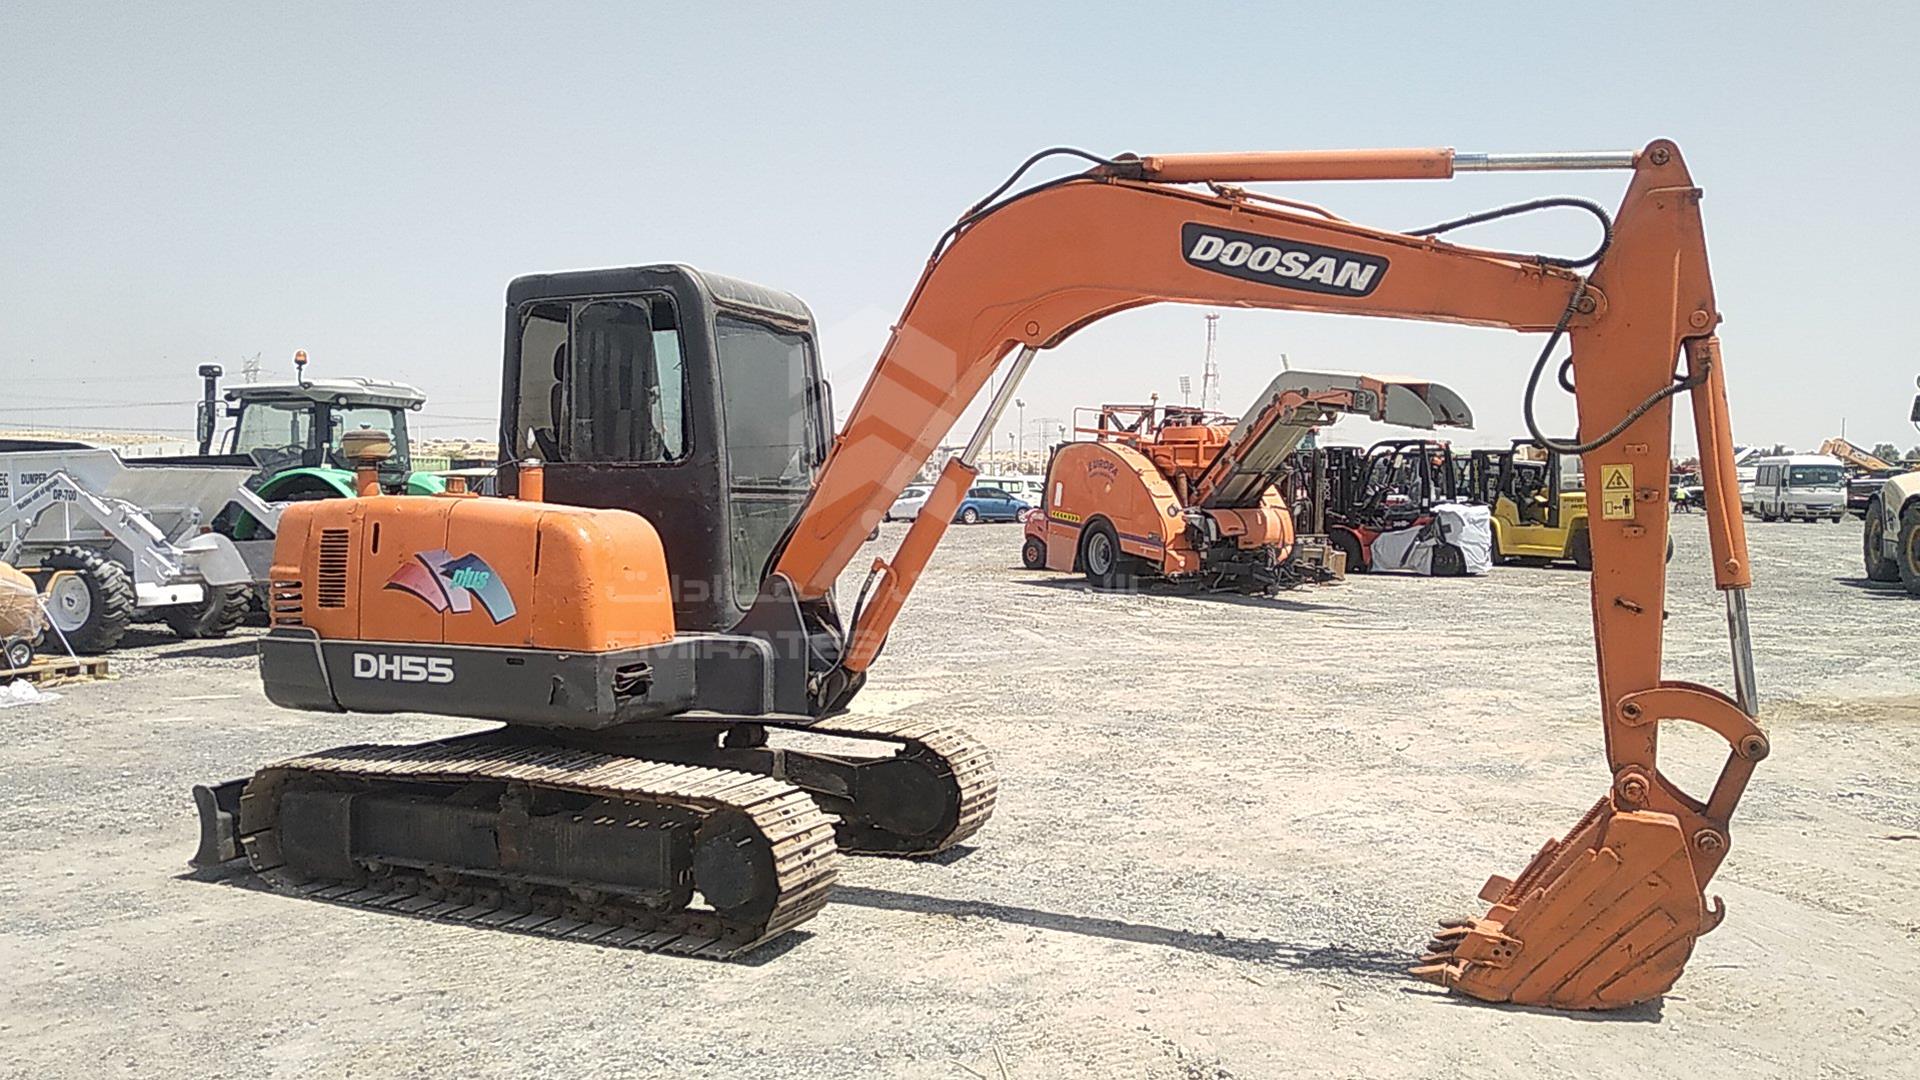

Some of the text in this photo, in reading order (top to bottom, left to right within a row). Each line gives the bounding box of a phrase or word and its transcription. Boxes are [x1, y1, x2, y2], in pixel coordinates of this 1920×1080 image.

[1188, 234, 1379, 291] DOOSAN
[452, 566, 490, 590] plus
[353, 652, 455, 684] DH55
